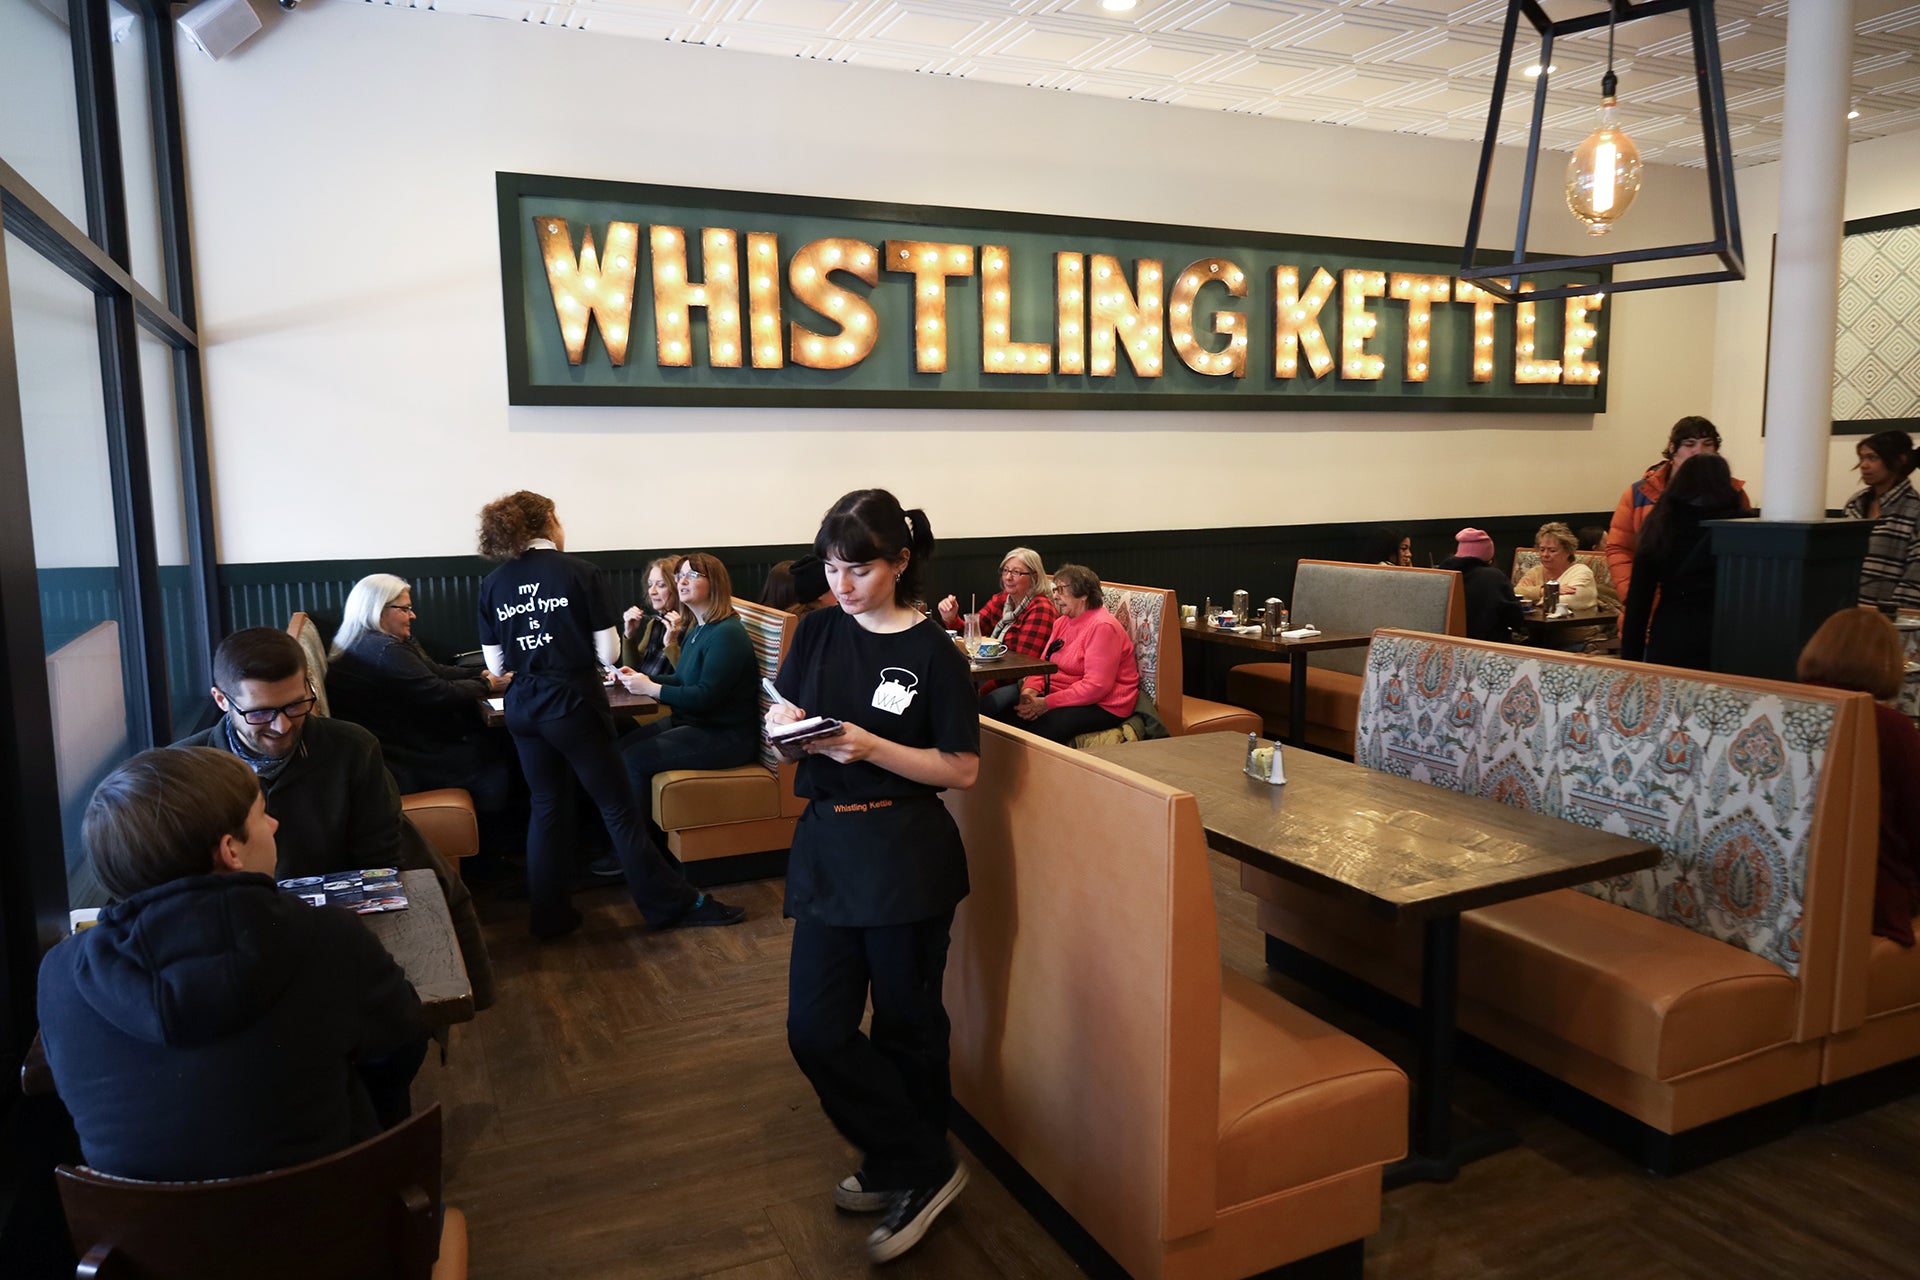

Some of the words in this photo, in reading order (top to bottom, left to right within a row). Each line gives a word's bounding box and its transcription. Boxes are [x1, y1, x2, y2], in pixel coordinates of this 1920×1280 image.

[533, 215, 1248, 379] WHISTLING
[1275, 265, 1603, 385] KETTLE
[519, 583, 540, 596] my
[497, 597, 535, 621] blood
[538, 597, 568, 613] type
[529, 617, 540, 630] is
[877, 691, 905, 713] WK
[834, 804, 868, 813] Whistling
[869, 800, 892, 809] Kettle
